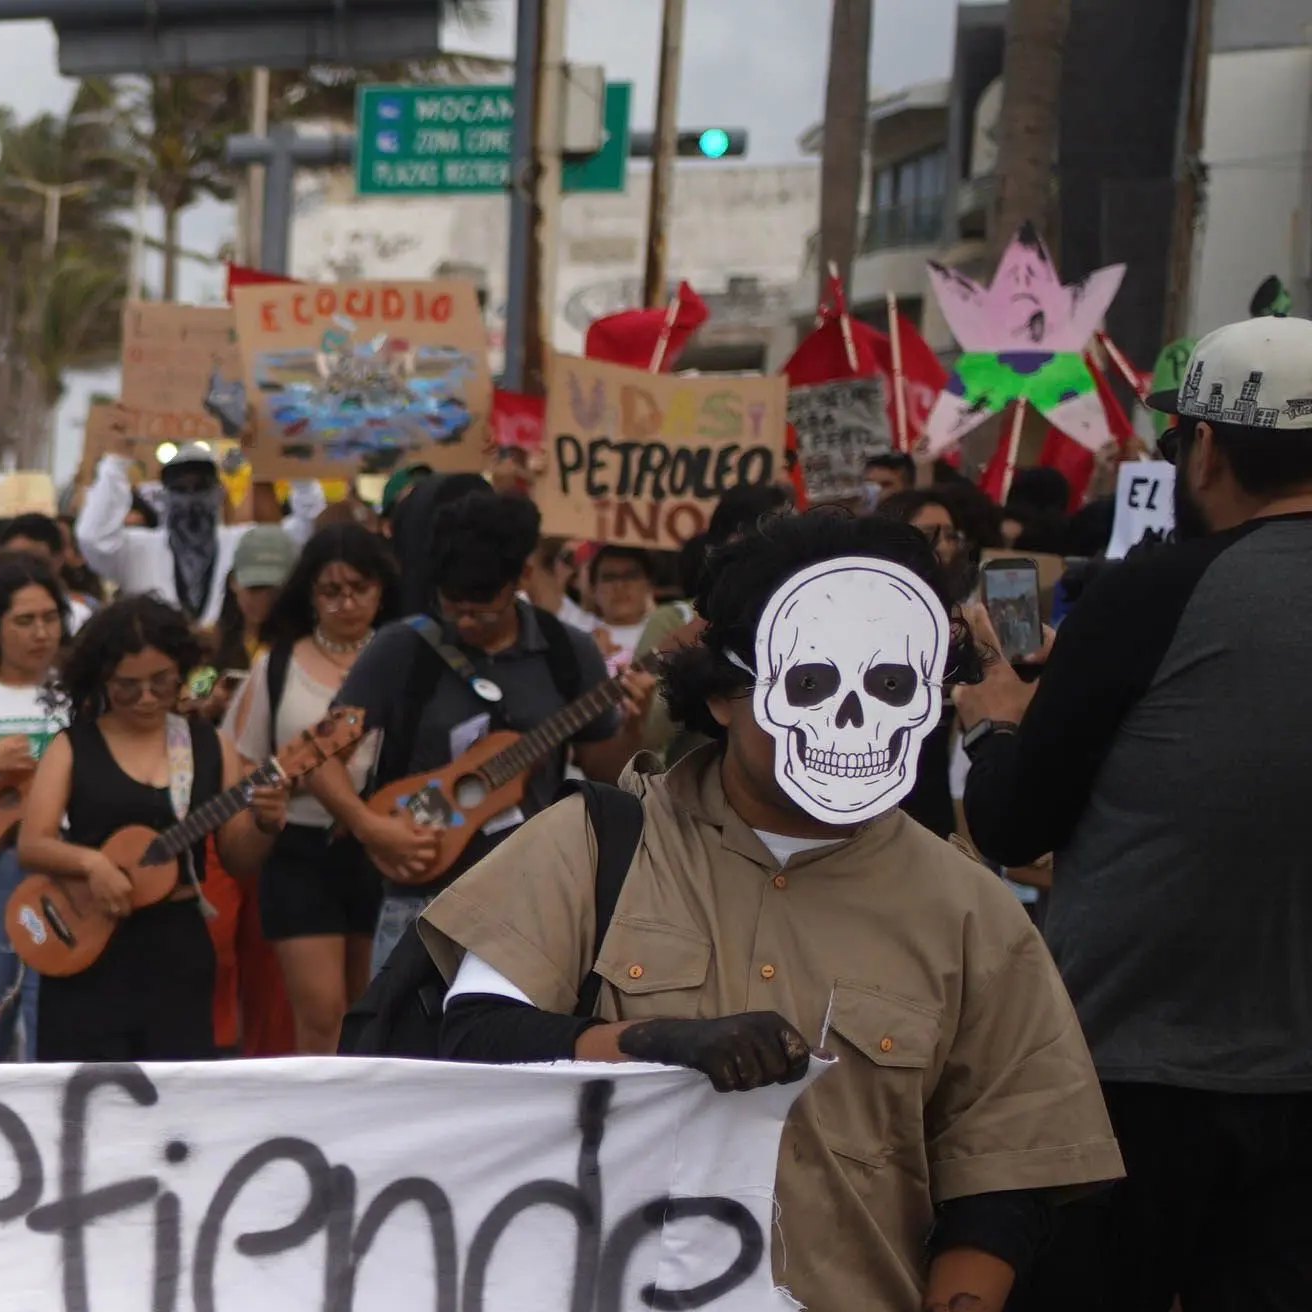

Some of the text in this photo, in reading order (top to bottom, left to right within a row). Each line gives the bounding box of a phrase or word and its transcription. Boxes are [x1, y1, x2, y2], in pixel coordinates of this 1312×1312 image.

[415, 129, 460, 153] ZONA
[259, 287, 455, 333] ECOCIDIO
[556, 431, 773, 499] PETROLEO
[1128, 477, 1160, 511] EL
